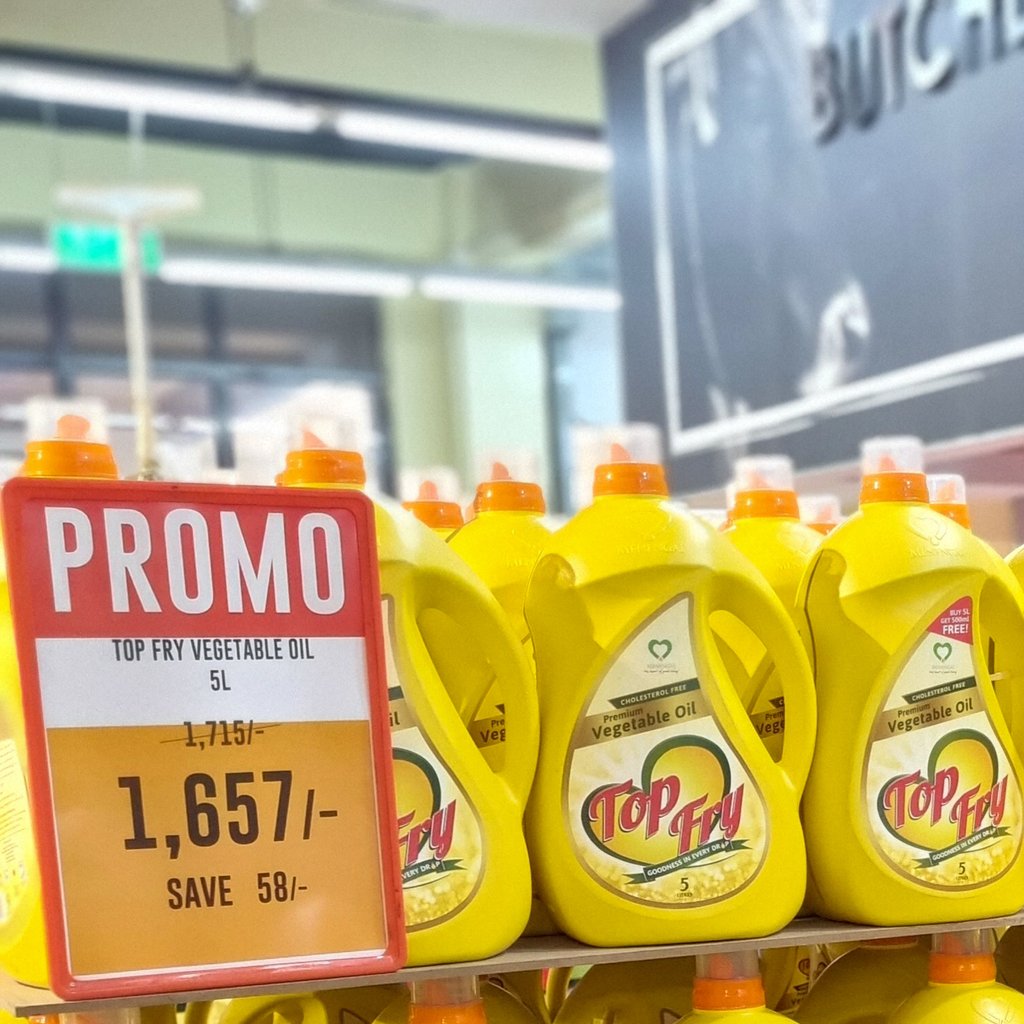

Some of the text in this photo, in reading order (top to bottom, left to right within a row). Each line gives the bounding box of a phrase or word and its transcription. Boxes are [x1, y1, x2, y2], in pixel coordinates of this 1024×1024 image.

[45, 506, 345, 615] PROMO
[942, 624, 969, 635] FREE!
[113, 638, 315, 661] TOP FRY VEGETABLE OIL
[210, 669, 231, 691] 5L
[621, 684, 687, 705] CHOLESTEROL FREE
[912, 687, 950, 701] CHOLESTEROL
[592, 702, 696, 739] Vegetable Oil
[604, 708, 642, 722] Premium
[888, 698, 971, 733] Vegetable Oil
[898, 704, 929, 717] Premium
[184, 720, 264, 750] 1,715/-
[118, 770, 339, 859] 1,657/-
[401, 868, 418, 880] VERY
[958, 862, 965, 875] 5
[167, 872, 308, 910] SAVE 58/-
[680, 878, 688, 891] 5
